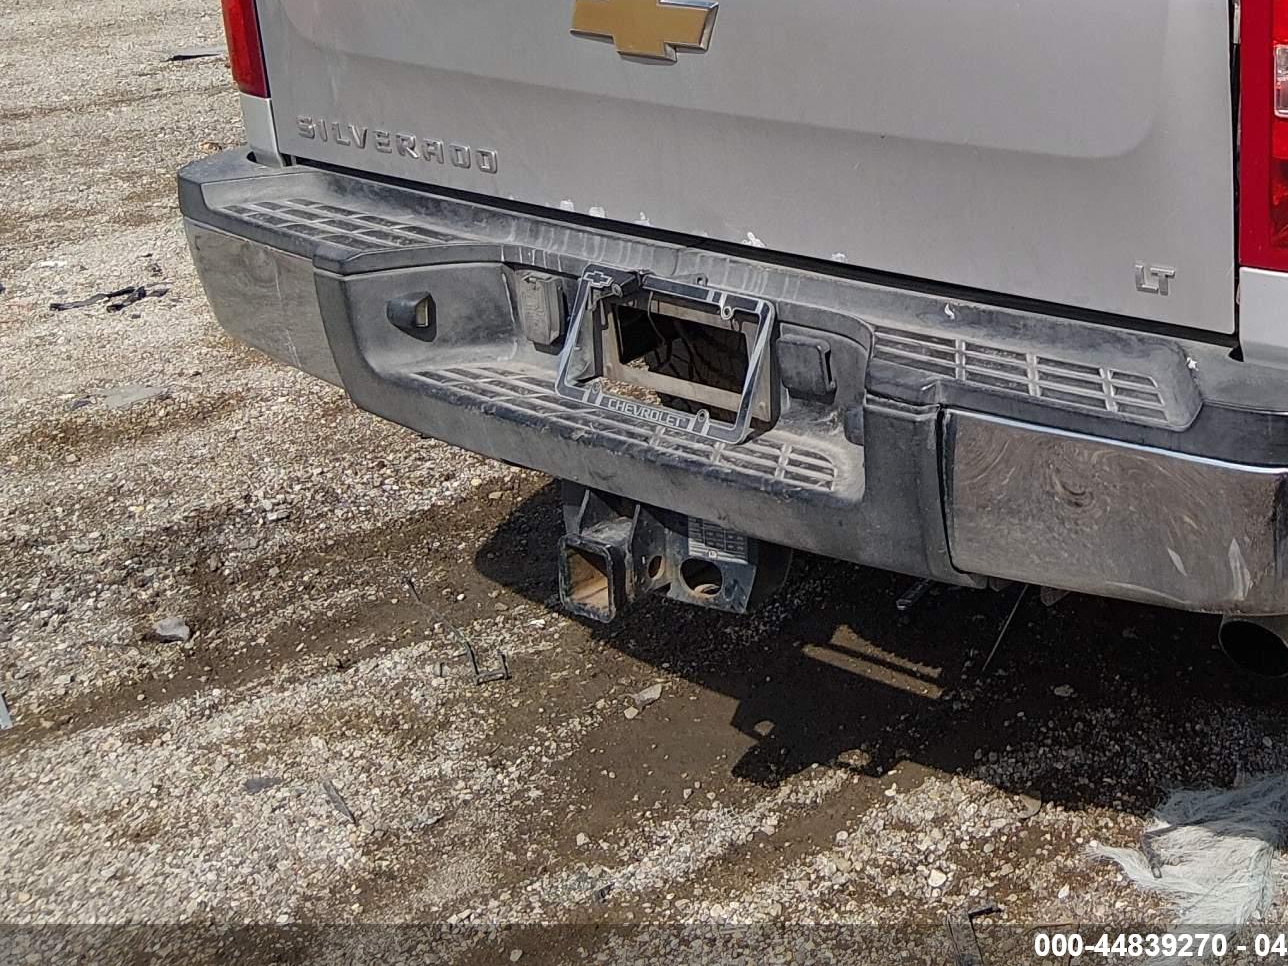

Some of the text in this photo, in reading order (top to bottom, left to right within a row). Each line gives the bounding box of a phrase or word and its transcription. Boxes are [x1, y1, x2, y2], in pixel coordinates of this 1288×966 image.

[296, 114, 499, 174] SILVERADO
[1134, 264, 1176, 296] LT
[607, 398, 681, 427] CHEVROLET
